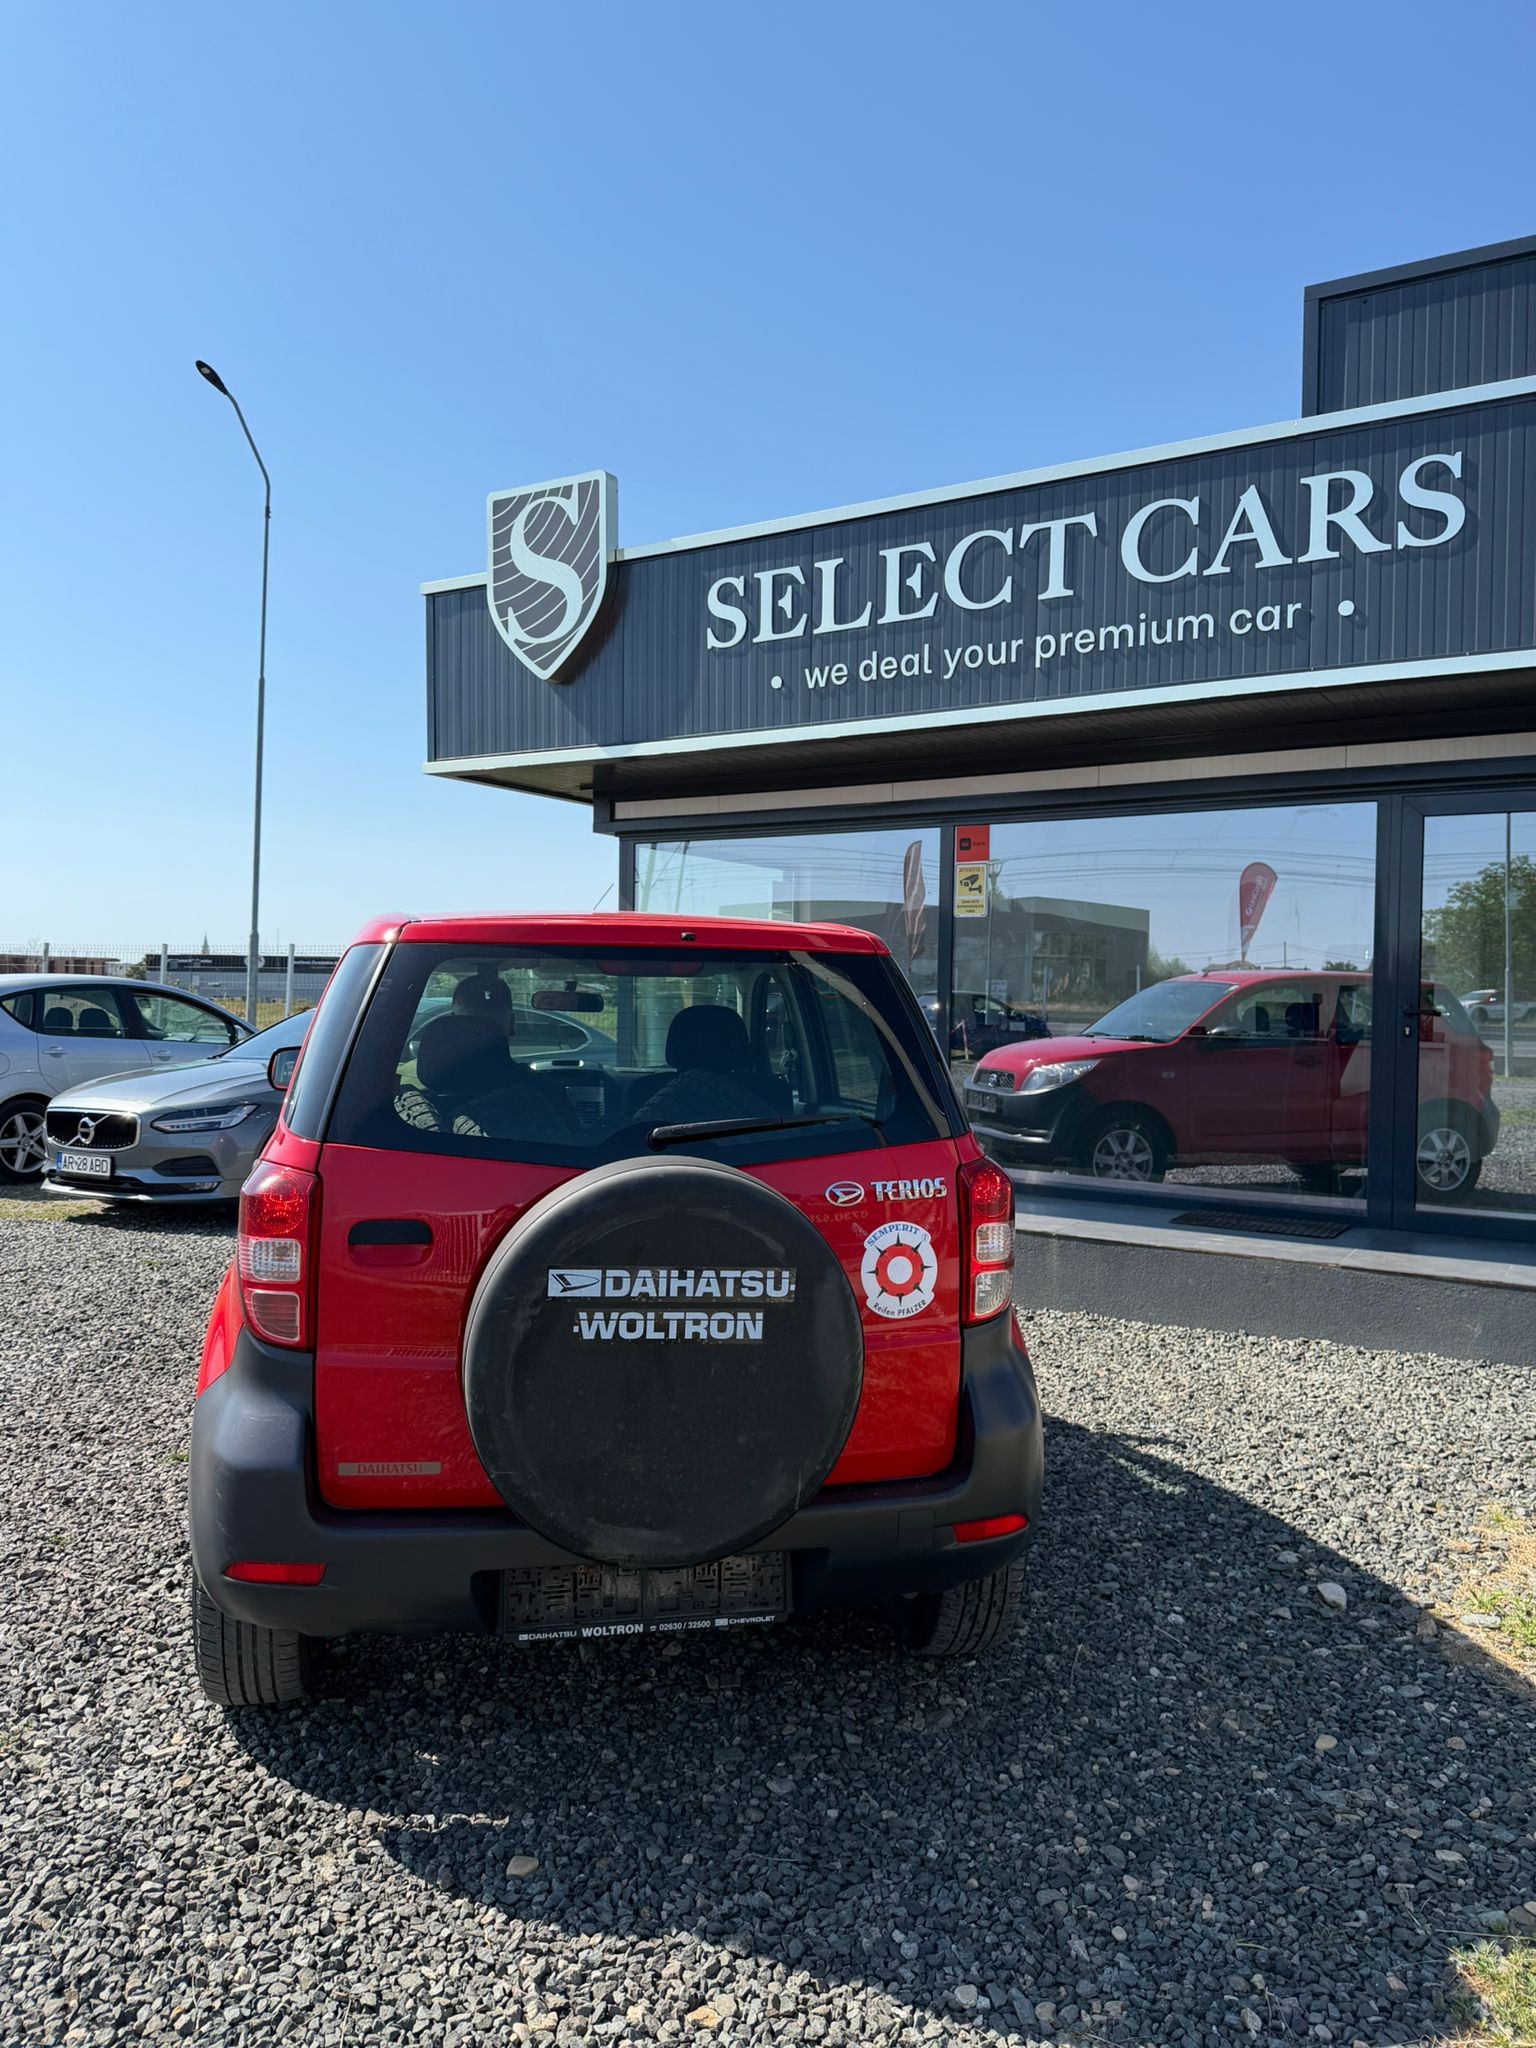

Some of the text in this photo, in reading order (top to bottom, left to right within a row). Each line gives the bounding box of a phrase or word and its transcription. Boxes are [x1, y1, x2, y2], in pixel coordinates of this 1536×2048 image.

[706, 451, 1466, 650] SELECT CARS
[804, 601, 1301, 689] we deal your premium car
[62, 1155, 109, 1173] AR 28 ABD
[870, 1177, 947, 1202] TERIOS
[867, 1223, 921, 1247] SEMPERIT
[604, 1269, 790, 1297] DAIHATSU
[873, 1299, 927, 1317] Reifen PFALZER
[578, 1311, 764, 1340] WOLTRON
[357, 1463, 422, 1474] DAIHATSU
[528, 1630, 577, 1640] DAIHATSU
[582, 1623, 644, 1637] WOLTRON
[659, 1622, 682, 1631] 02630
[688, 1620, 711, 1629] 32500
[729, 1615, 775, 1625] CHEVROLET
